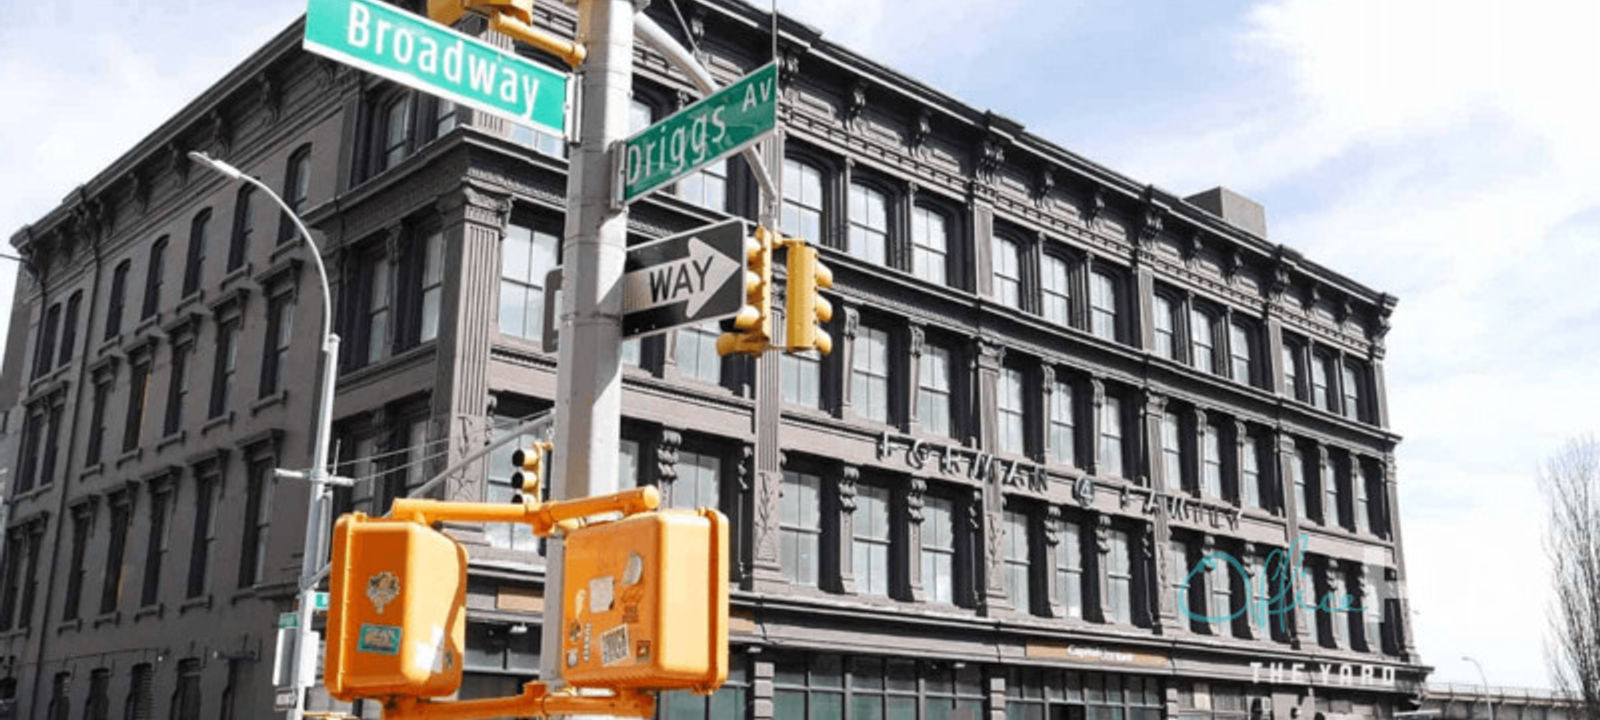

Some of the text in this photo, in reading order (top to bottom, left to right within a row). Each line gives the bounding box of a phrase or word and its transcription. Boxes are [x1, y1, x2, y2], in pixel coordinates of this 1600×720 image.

[346, 2, 539, 120] Broadway
[626, 77, 773, 176] Driggs Av
[650, 255, 714, 304] WAY
[1250, 662, 1396, 687] THE YARD
